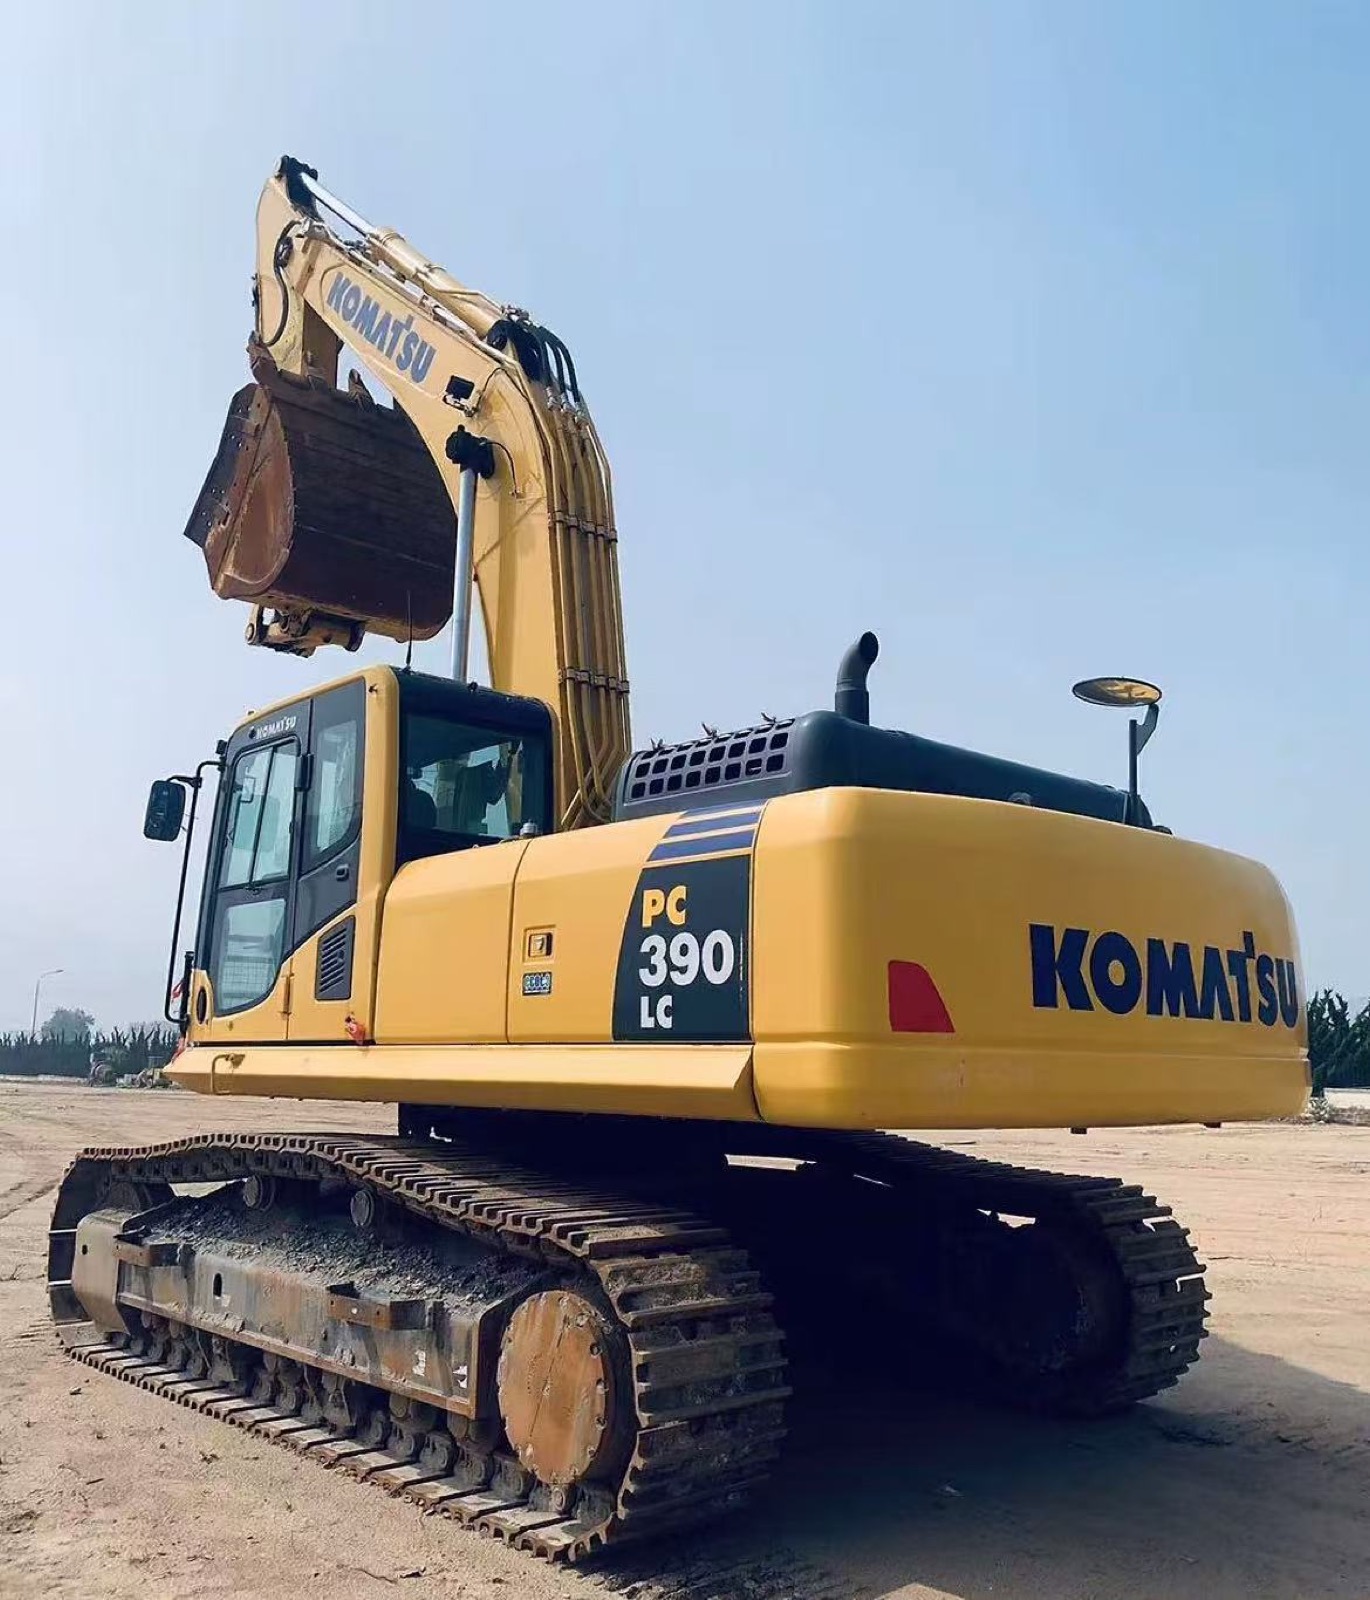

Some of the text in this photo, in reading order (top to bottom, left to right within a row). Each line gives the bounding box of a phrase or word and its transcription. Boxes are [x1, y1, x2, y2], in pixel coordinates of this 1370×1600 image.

[326, 272, 437, 383] KOMATSU
[642, 885, 687, 928] PC
[638, 929, 735, 987] 390
[1029, 923, 1299, 1029] KOMATSU
[639, 995, 673, 1029] LC
